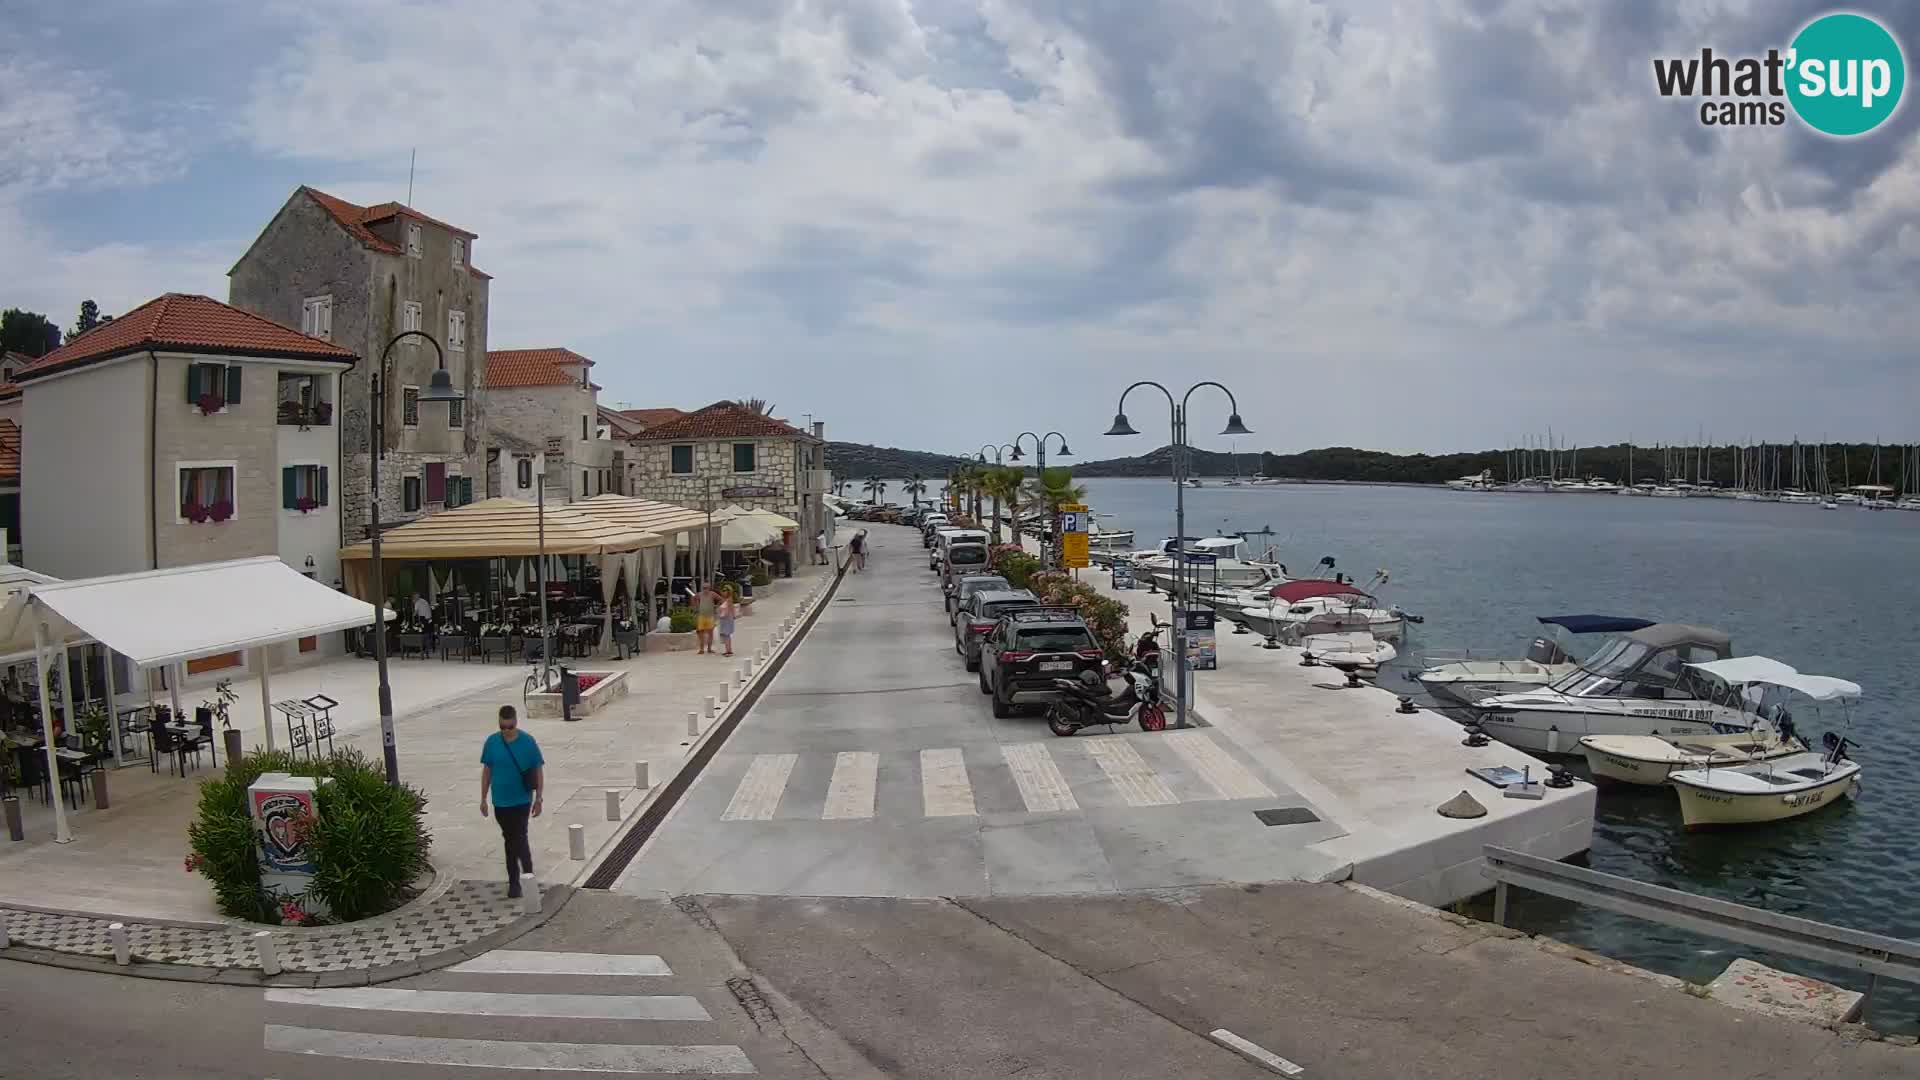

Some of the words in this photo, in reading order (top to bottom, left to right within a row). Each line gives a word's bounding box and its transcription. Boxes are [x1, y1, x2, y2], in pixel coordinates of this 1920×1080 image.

[1065, 514, 1076, 530] P
[1668, 708, 1688, 719] RENT
[1695, 709, 1714, 720] BOAT
